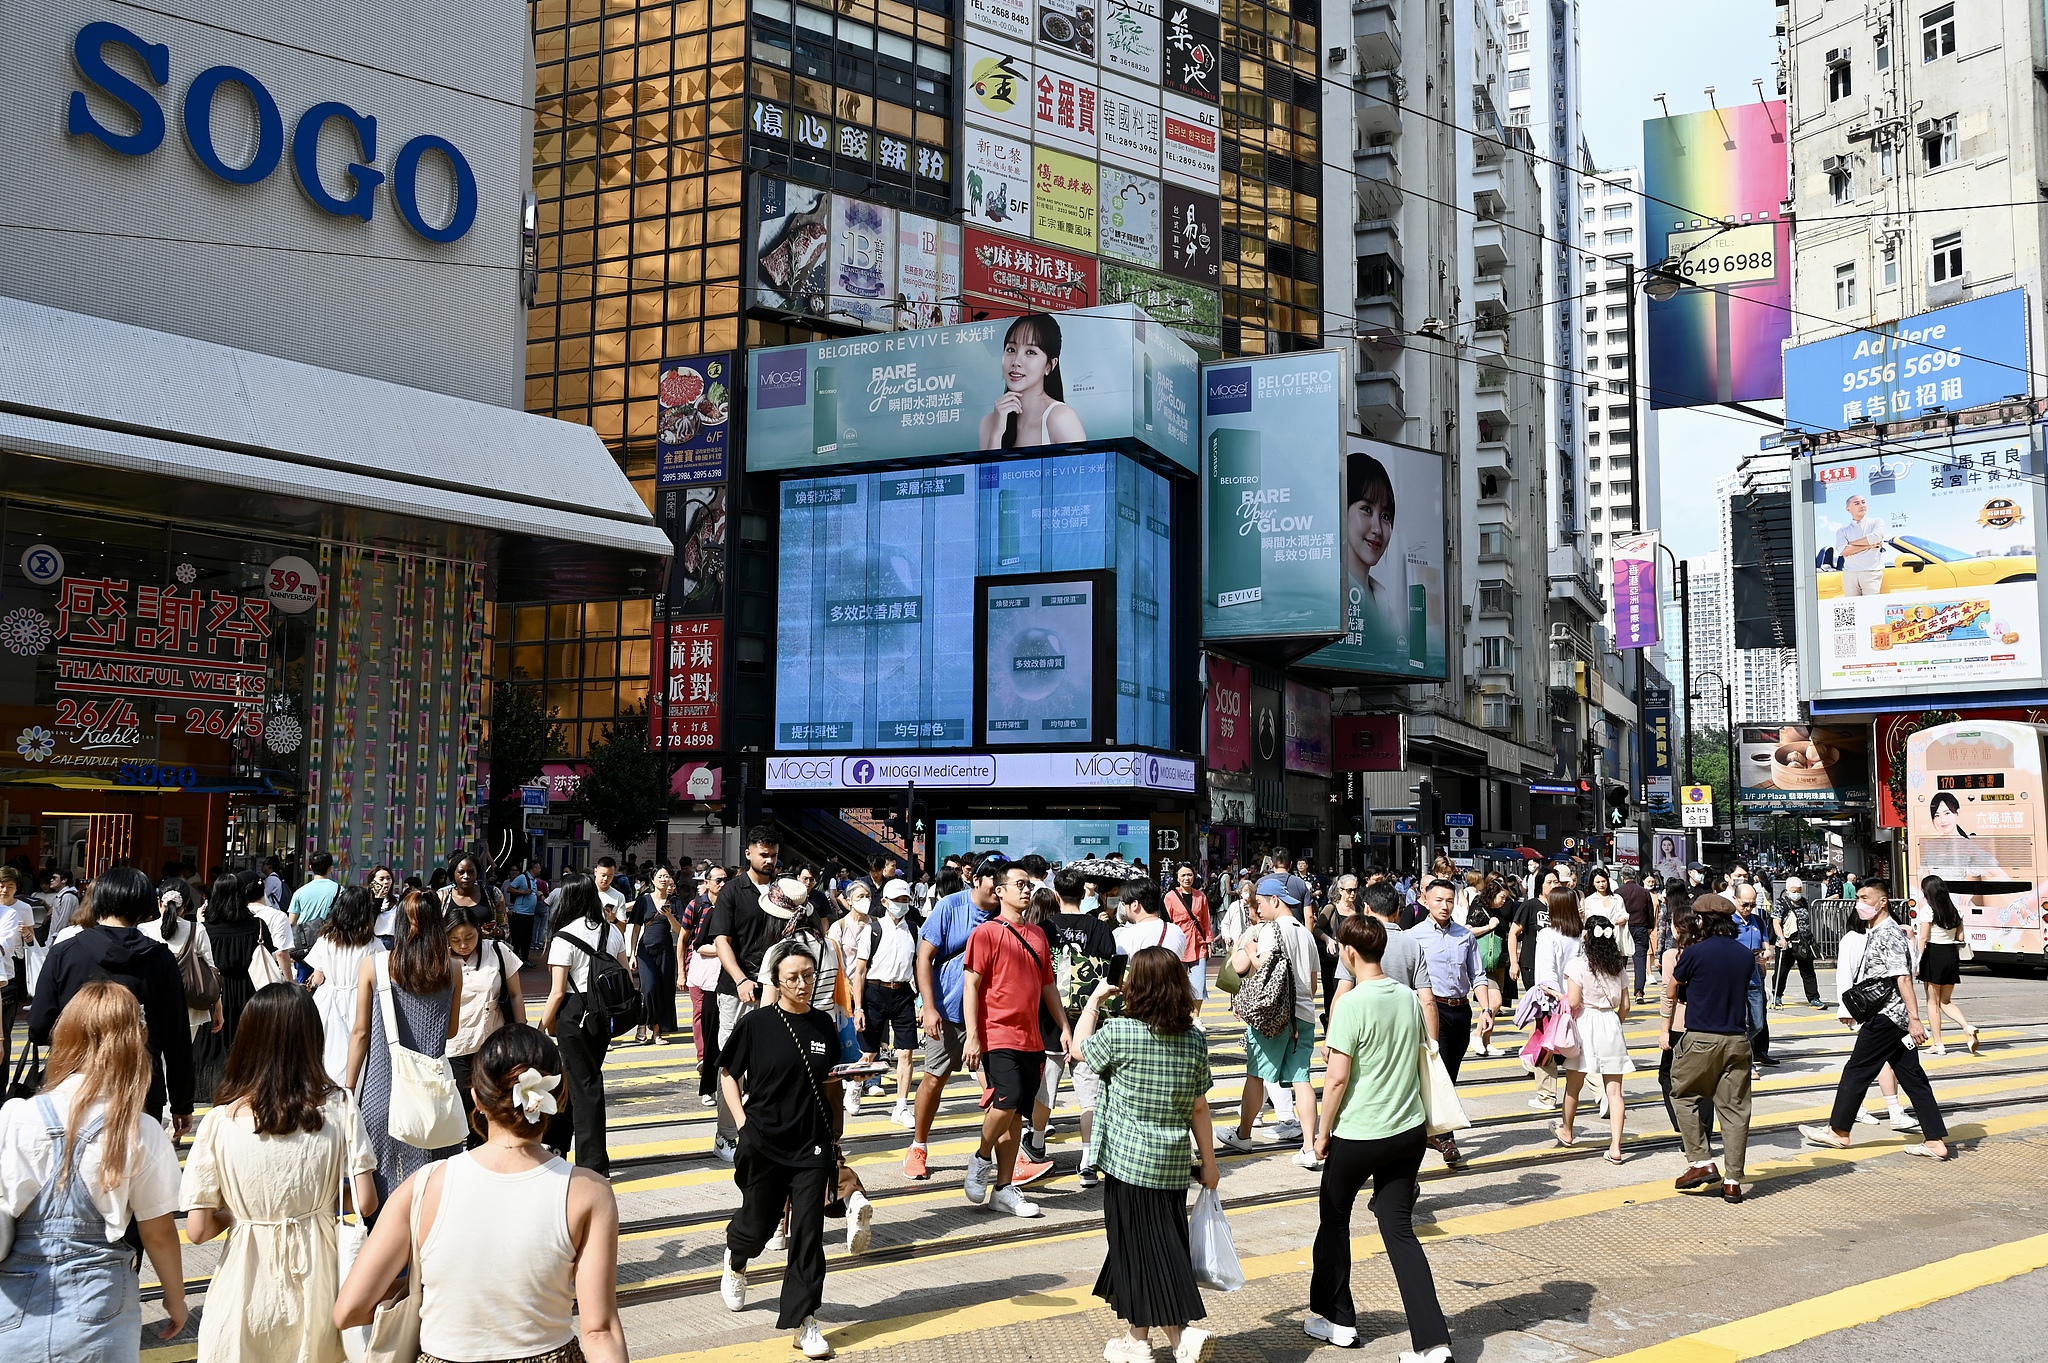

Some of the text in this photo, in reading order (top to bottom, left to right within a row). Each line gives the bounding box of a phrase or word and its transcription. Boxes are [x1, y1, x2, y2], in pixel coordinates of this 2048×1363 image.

[991, 5, 1010, 19] 2668
[1011, 14, 1030, 26] 8483
[1137, 1, 1155, 14] 7/F
[1120, 58, 1150, 73] 36188230
[1037, 74, 1095, 136] 金羅寶
[1103, 97, 1159, 142] 韓國料理
[1199, 112, 1215, 125] 6/F
[67, 21, 478, 243] SOGO
[1168, 123, 1213, 147] 금라보 한국요리
[977, 139, 1022, 164] 新巴黎
[1104, 132, 1158, 155] TEL:2895 3986
[1165, 152, 1216, 173] TEL:2895 6398
[987, 168, 1008, 178] Vietnamese
[1008, 174, 1029, 184] Restaurant
[1053, 175, 1094, 196] 酸辣粉
[765, 204, 777, 214] 3F
[1010, 199, 1029, 214] 5/F
[1079, 206, 1094, 221] 5/F
[1038, 215, 1093, 238] 正宗重慶風味
[993, 245, 1074, 283] 麻辣派對
[1208, 264, 1218, 275] 5F
[1723, 251, 1772, 272] 6988
[1030, 278, 1073, 300] PARTY
[818, 326, 996, 360] BELOTERO REVIVE 水光針
[1853, 324, 1946, 361] Ad Here
[872, 363, 917, 381] BARE
[1842, 346, 1962, 393] 9556 5696
[1157, 371, 1174, 393] BARE
[1258, 370, 1332, 389] BELOTERO
[866, 374, 956, 413] Your GLOW
[1258, 383, 1333, 399] REVIVE 水光針
[1842, 376, 1964, 424] 廣告位招租
[888, 391, 963, 412] 瞬間水潤光澤
[1168, 394, 1186, 415] GLOW
[901, 408, 961, 427] 長效9個月
[706, 431, 723, 443] 6/F
[664, 450, 694, 465] 金羅寶
[1931, 448, 2022, 474] 我信 馬百良
[663, 473, 677, 482] 2895
[693, 470, 707, 479] 2895
[707, 469, 722, 478] 6398
[1002, 469, 1041, 480] BELOTERO
[1045, 465, 1085, 477] REVIVE
[1220, 475, 1259, 485] BELOTERO
[1823, 467, 1852, 479] 馬百良
[1930, 467, 2022, 490] 安宮牛黃丸
[896, 479, 946, 496] 深層保濕
[1242, 488, 1290, 504] BARE
[1236, 502, 1277, 536] Your
[1257, 515, 1313, 534] GLOW
[1262, 534, 1334, 549] 瞬間水潤光澤
[1273, 547, 1333, 562] 長效9個月
[269, 568, 318, 595] 39TH
[268, 590, 317, 603] ANNIVERSARY
[1220, 589, 1260, 603] REVIVE
[1628, 564, 1640, 642] 香港亞洲國際都會
[54, 576, 272, 659] 感謝祭
[830, 601, 918, 622] 多效改善膚質
[692, 623, 709, 633] 4/F
[1016, 659, 1063, 669] 多效改善膚質
[56, 659, 267, 693] THANKFUL WEEKS
[54, 698, 265, 739] 26/4 26/5
[684, 706, 710, 716] PARTY
[69, 722, 140, 744] Kiehl's
[791, 724, 838, 739] 提升彈性
[894, 722, 945, 737] 均勻膚色
[1221, 717, 1235, 739] 莎莎
[655, 734, 714, 746] 278 4898
[1655, 716, 1668, 767] IKEA
[50, 755, 119, 768] CALENDULA
[879, 764, 989, 778] MIOGGI MediCentre
[119, 763, 198, 788] SOGO
[1160, 766, 1177, 780] MIOGGI
[1940, 776, 1955, 789] 170
[1788, 792, 1835, 800] 翡翠明珠廣場
[1688, 815, 1706, 825] 全日
[1976, 812, 2025, 824] 六福珠寶
[1971, 933, 1987, 941] KMB
